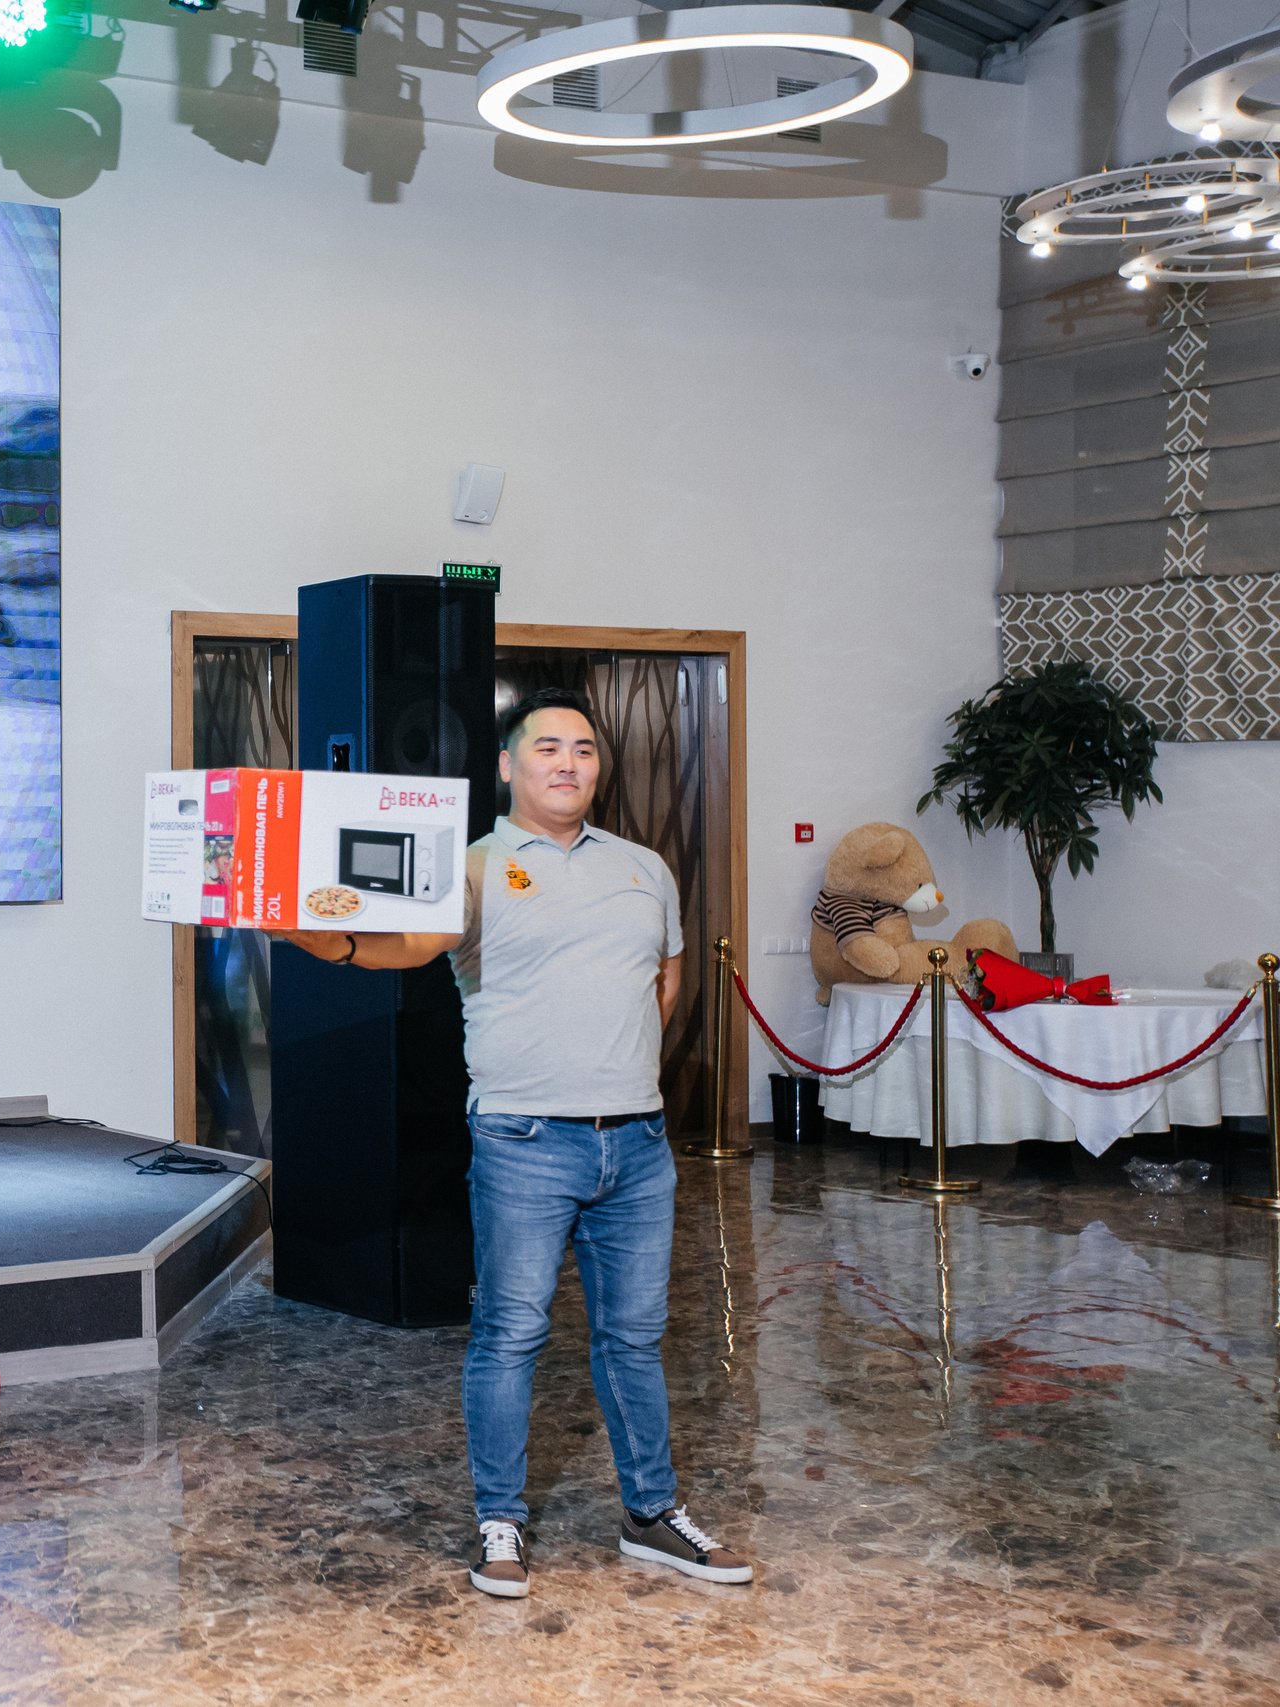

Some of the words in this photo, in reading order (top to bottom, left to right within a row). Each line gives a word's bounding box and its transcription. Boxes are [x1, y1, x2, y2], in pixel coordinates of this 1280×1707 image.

[256, 777, 268, 810] ПЕЧЬ
[399, 791, 439, 808] BEKA
[253, 811, 266, 920] МИКРОВОЛНОВАЯ
[267, 892, 281, 921] 20L
